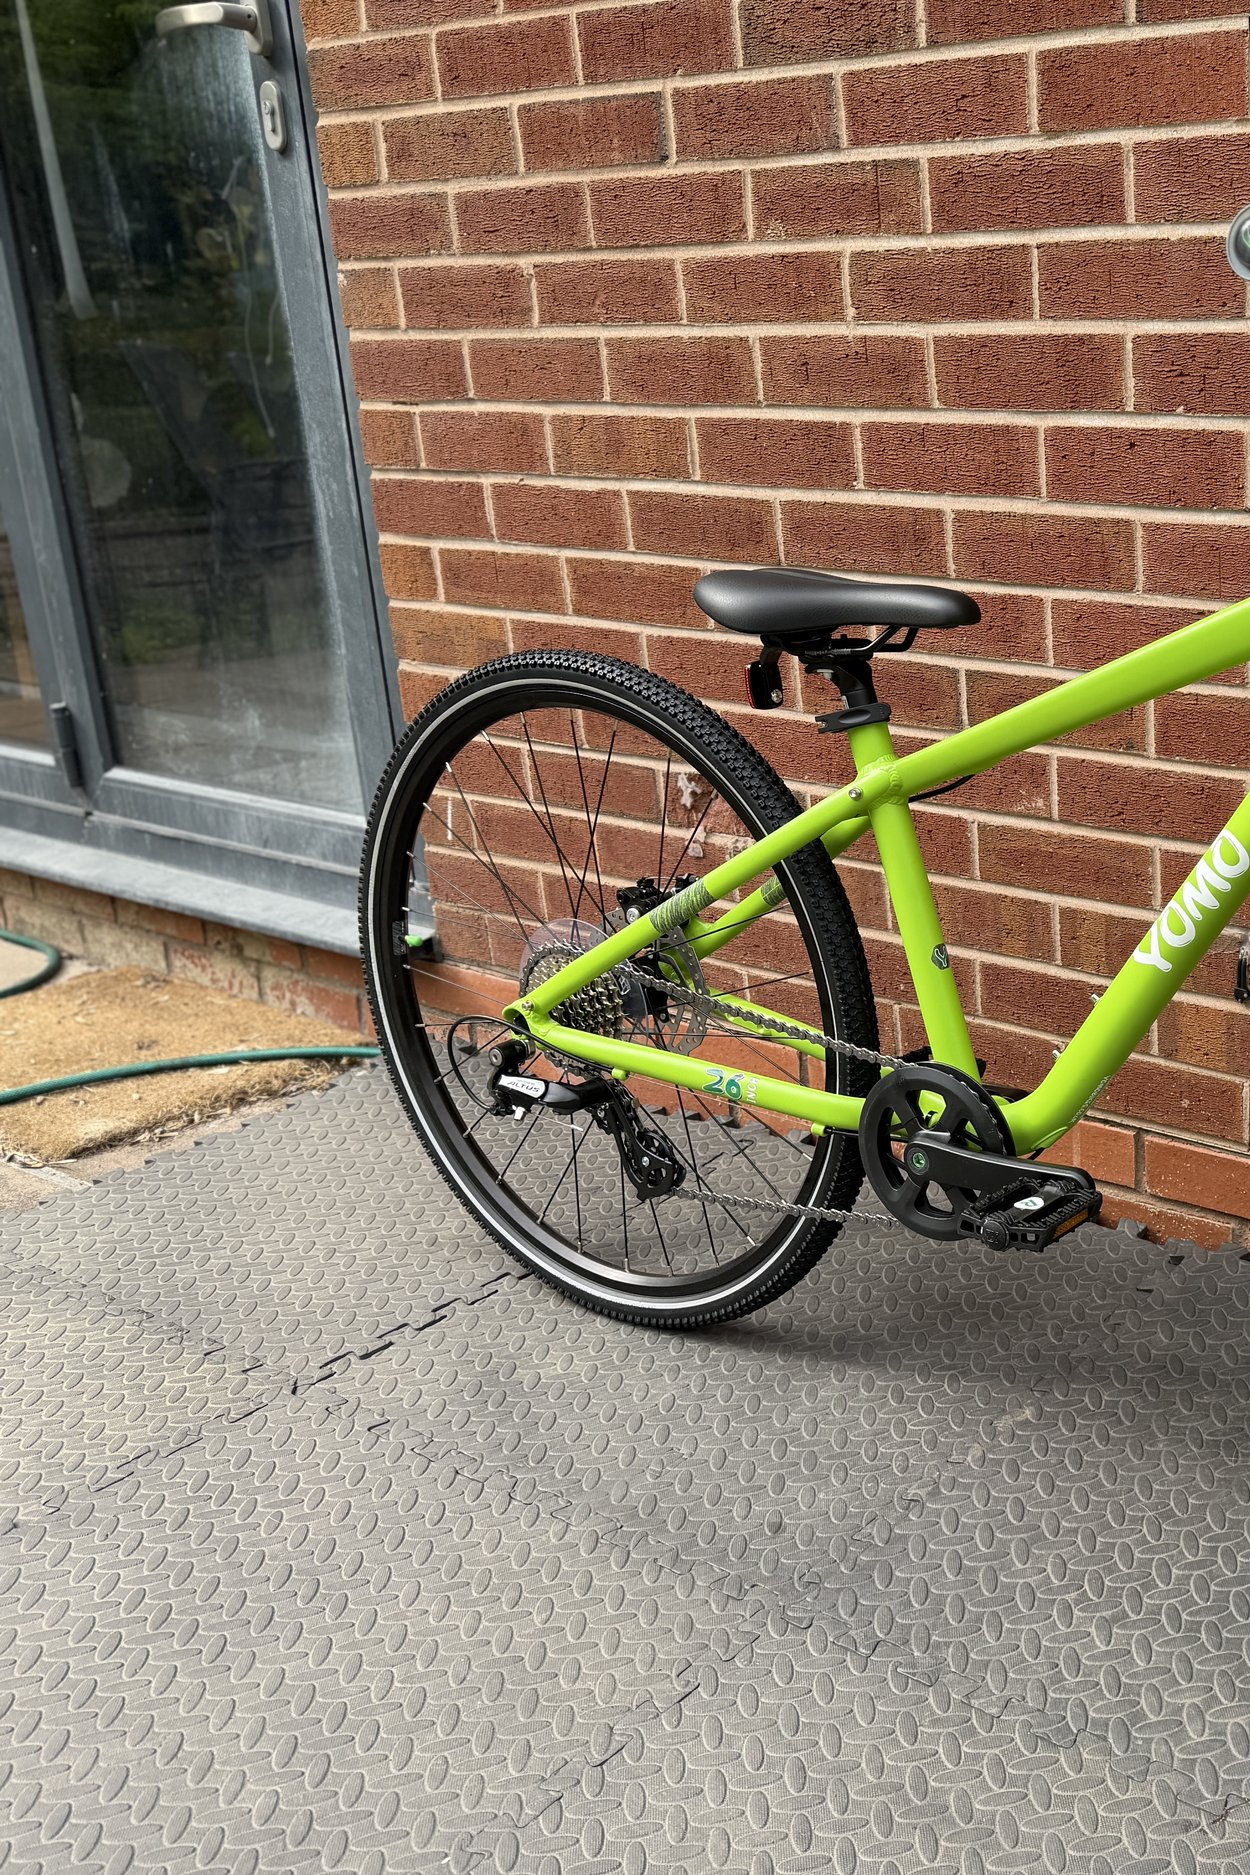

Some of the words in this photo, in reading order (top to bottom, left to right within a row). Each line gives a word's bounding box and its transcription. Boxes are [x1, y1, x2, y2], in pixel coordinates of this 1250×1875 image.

[1132, 829, 1250, 973] YOMO
[507, 1081, 541, 1092] ALTUS
[702, 1067, 745, 1100] 26
[746, 1077, 762, 1105] INCH
